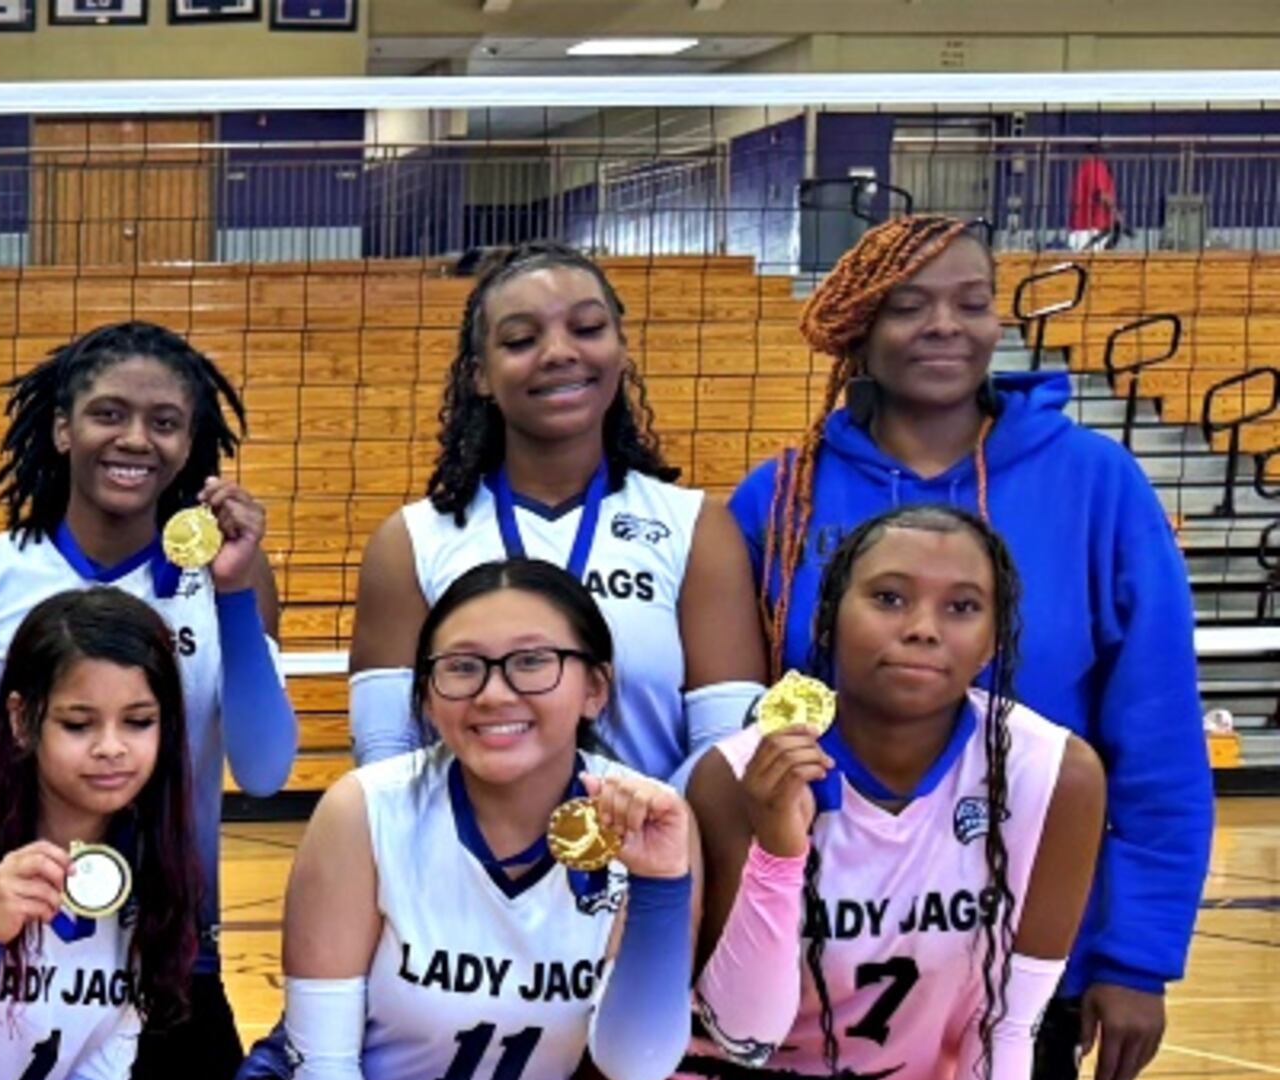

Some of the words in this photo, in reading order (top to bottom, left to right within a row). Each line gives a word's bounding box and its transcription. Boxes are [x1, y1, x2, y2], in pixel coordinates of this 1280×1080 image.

[586, 568, 655, 602] AGS
[399, 942, 512, 997] LADY
[845, 956, 921, 1046] 7
